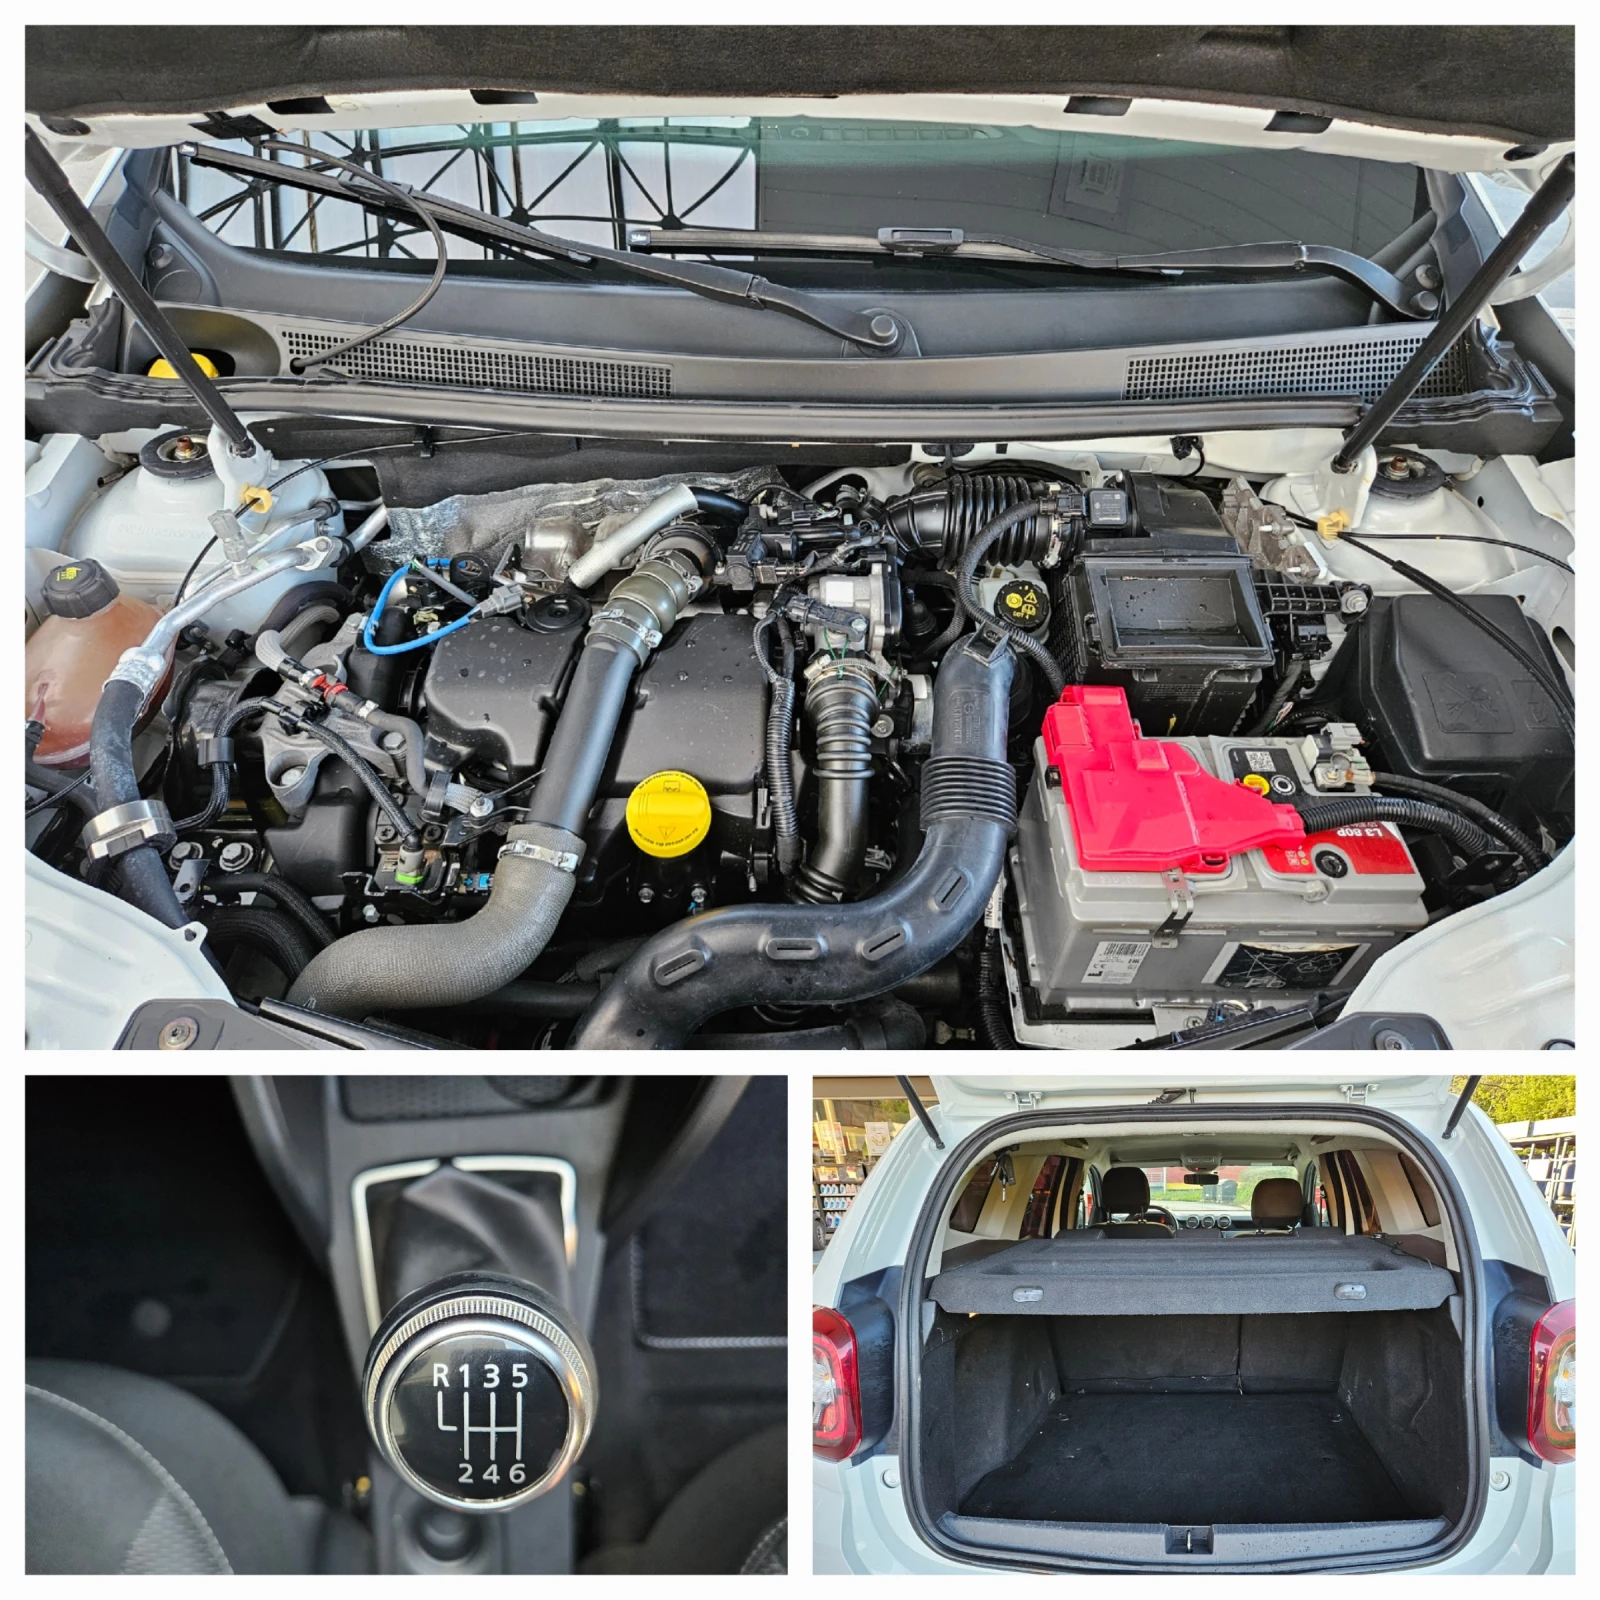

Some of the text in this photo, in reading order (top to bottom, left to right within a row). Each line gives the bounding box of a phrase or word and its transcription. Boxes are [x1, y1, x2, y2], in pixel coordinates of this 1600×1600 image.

[1337, 827, 1383, 837] L3 80P
[433, 1363, 528, 1388] R 1 3 5
[458, 1463, 526, 1484] 2 4 6
